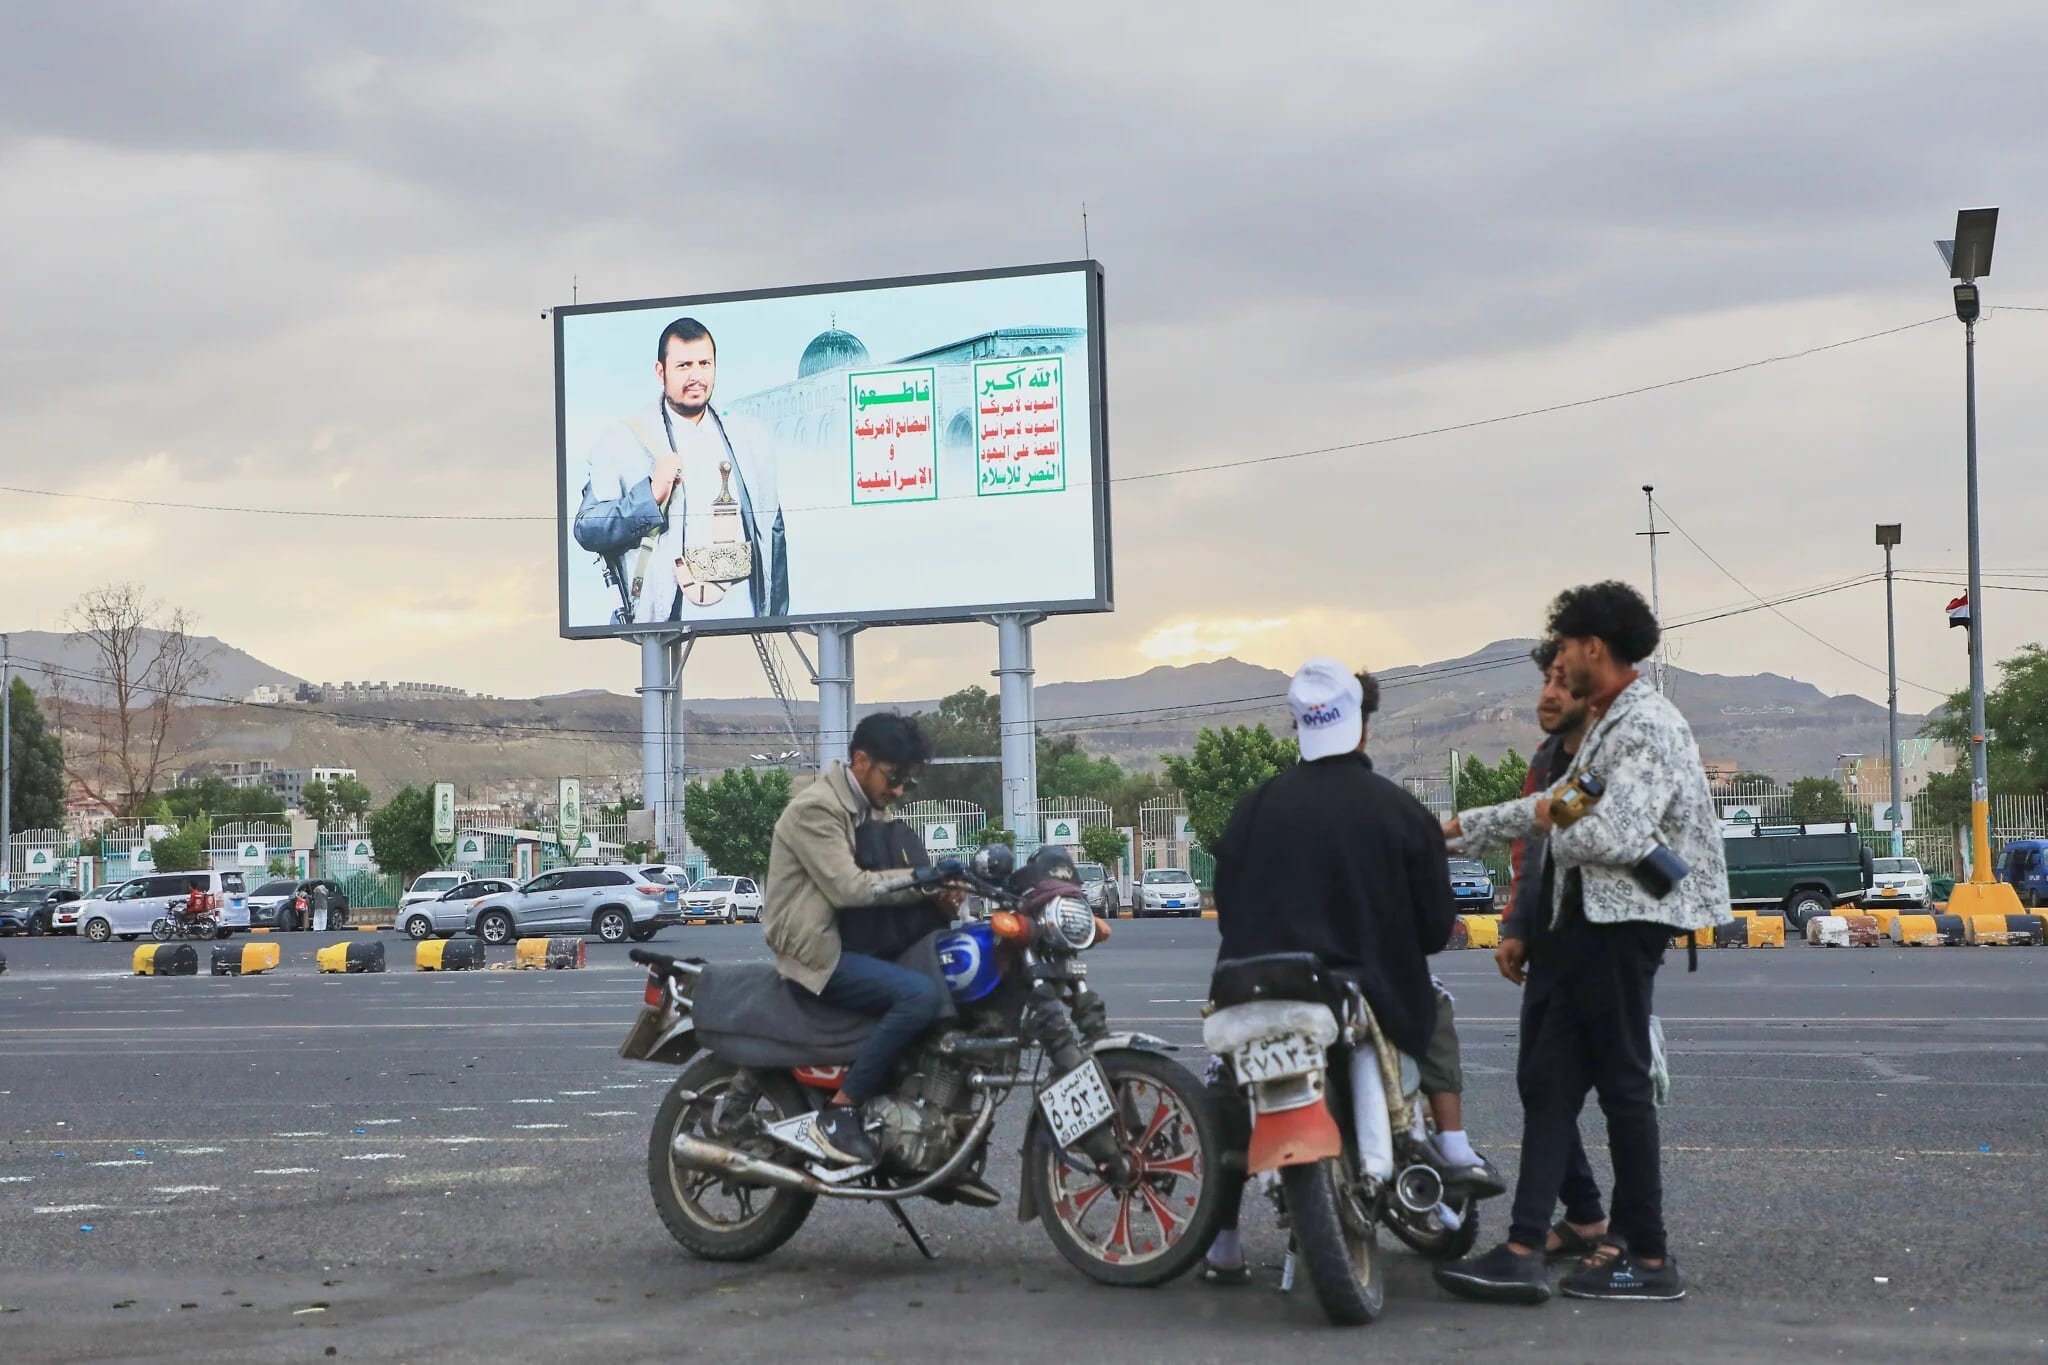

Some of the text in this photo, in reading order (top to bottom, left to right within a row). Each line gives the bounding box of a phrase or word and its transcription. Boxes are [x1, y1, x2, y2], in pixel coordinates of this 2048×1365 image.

[1028, 367, 1058, 388] الله
[1024, 396, 1058, 414] الموت
[895, 415, 930, 438] البضائع
[1025, 419, 1059, 437] الموت
[889, 443, 895, 461] و
[981, 441, 1059, 463] اللعنة على اليهود
[1025, 461, 1060, 487] النصر
[1052, 1089, 1091, 1130] ٥٠٥٣
